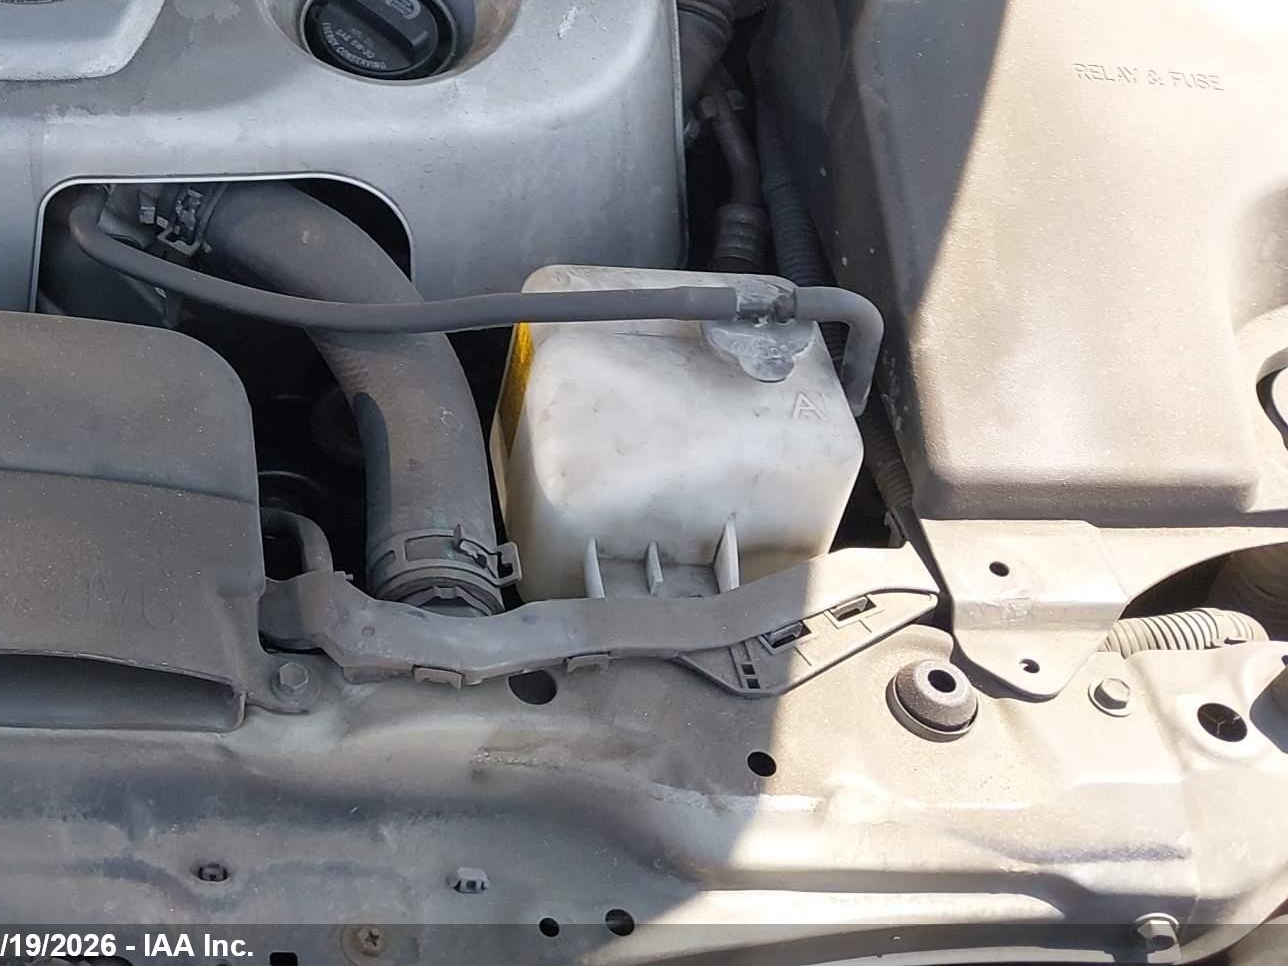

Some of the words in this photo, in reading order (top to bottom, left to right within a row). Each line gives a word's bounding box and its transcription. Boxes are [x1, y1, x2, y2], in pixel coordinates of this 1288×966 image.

[1072, 63, 1138, 84] RELAY
[1146, 69, 1165, 86] &
[1168, 70, 1225, 92] FUSE
